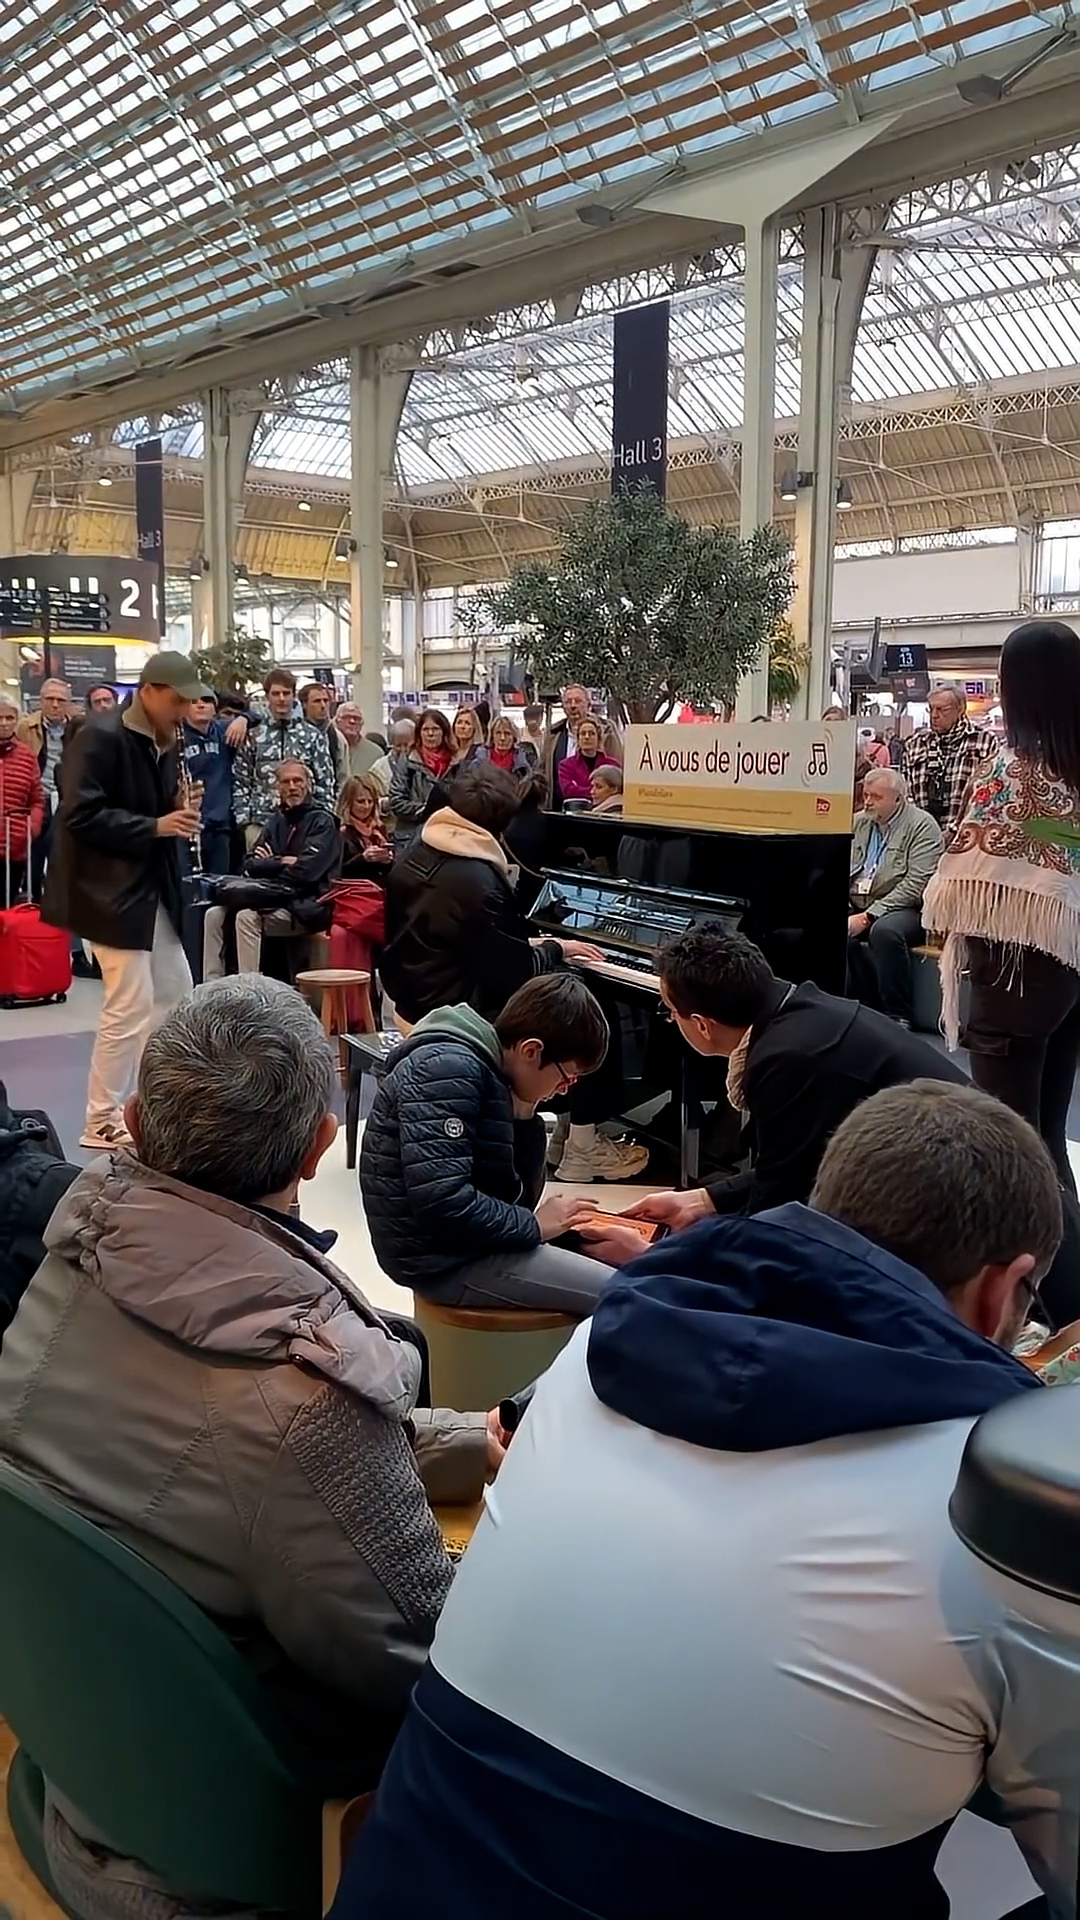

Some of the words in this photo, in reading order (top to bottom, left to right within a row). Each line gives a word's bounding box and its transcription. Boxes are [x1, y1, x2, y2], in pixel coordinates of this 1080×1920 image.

[612, 440, 647, 467] Hall
[651, 437, 662, 461] 3
[155, 530, 162, 547] 3
[120, 578, 141, 618] 2
[899, 652, 913, 665] 13
[639, 734, 653, 771] À
[658, 750, 700, 772] vous
[705, 739, 730, 773] de
[733, 741, 790, 784] jouer
